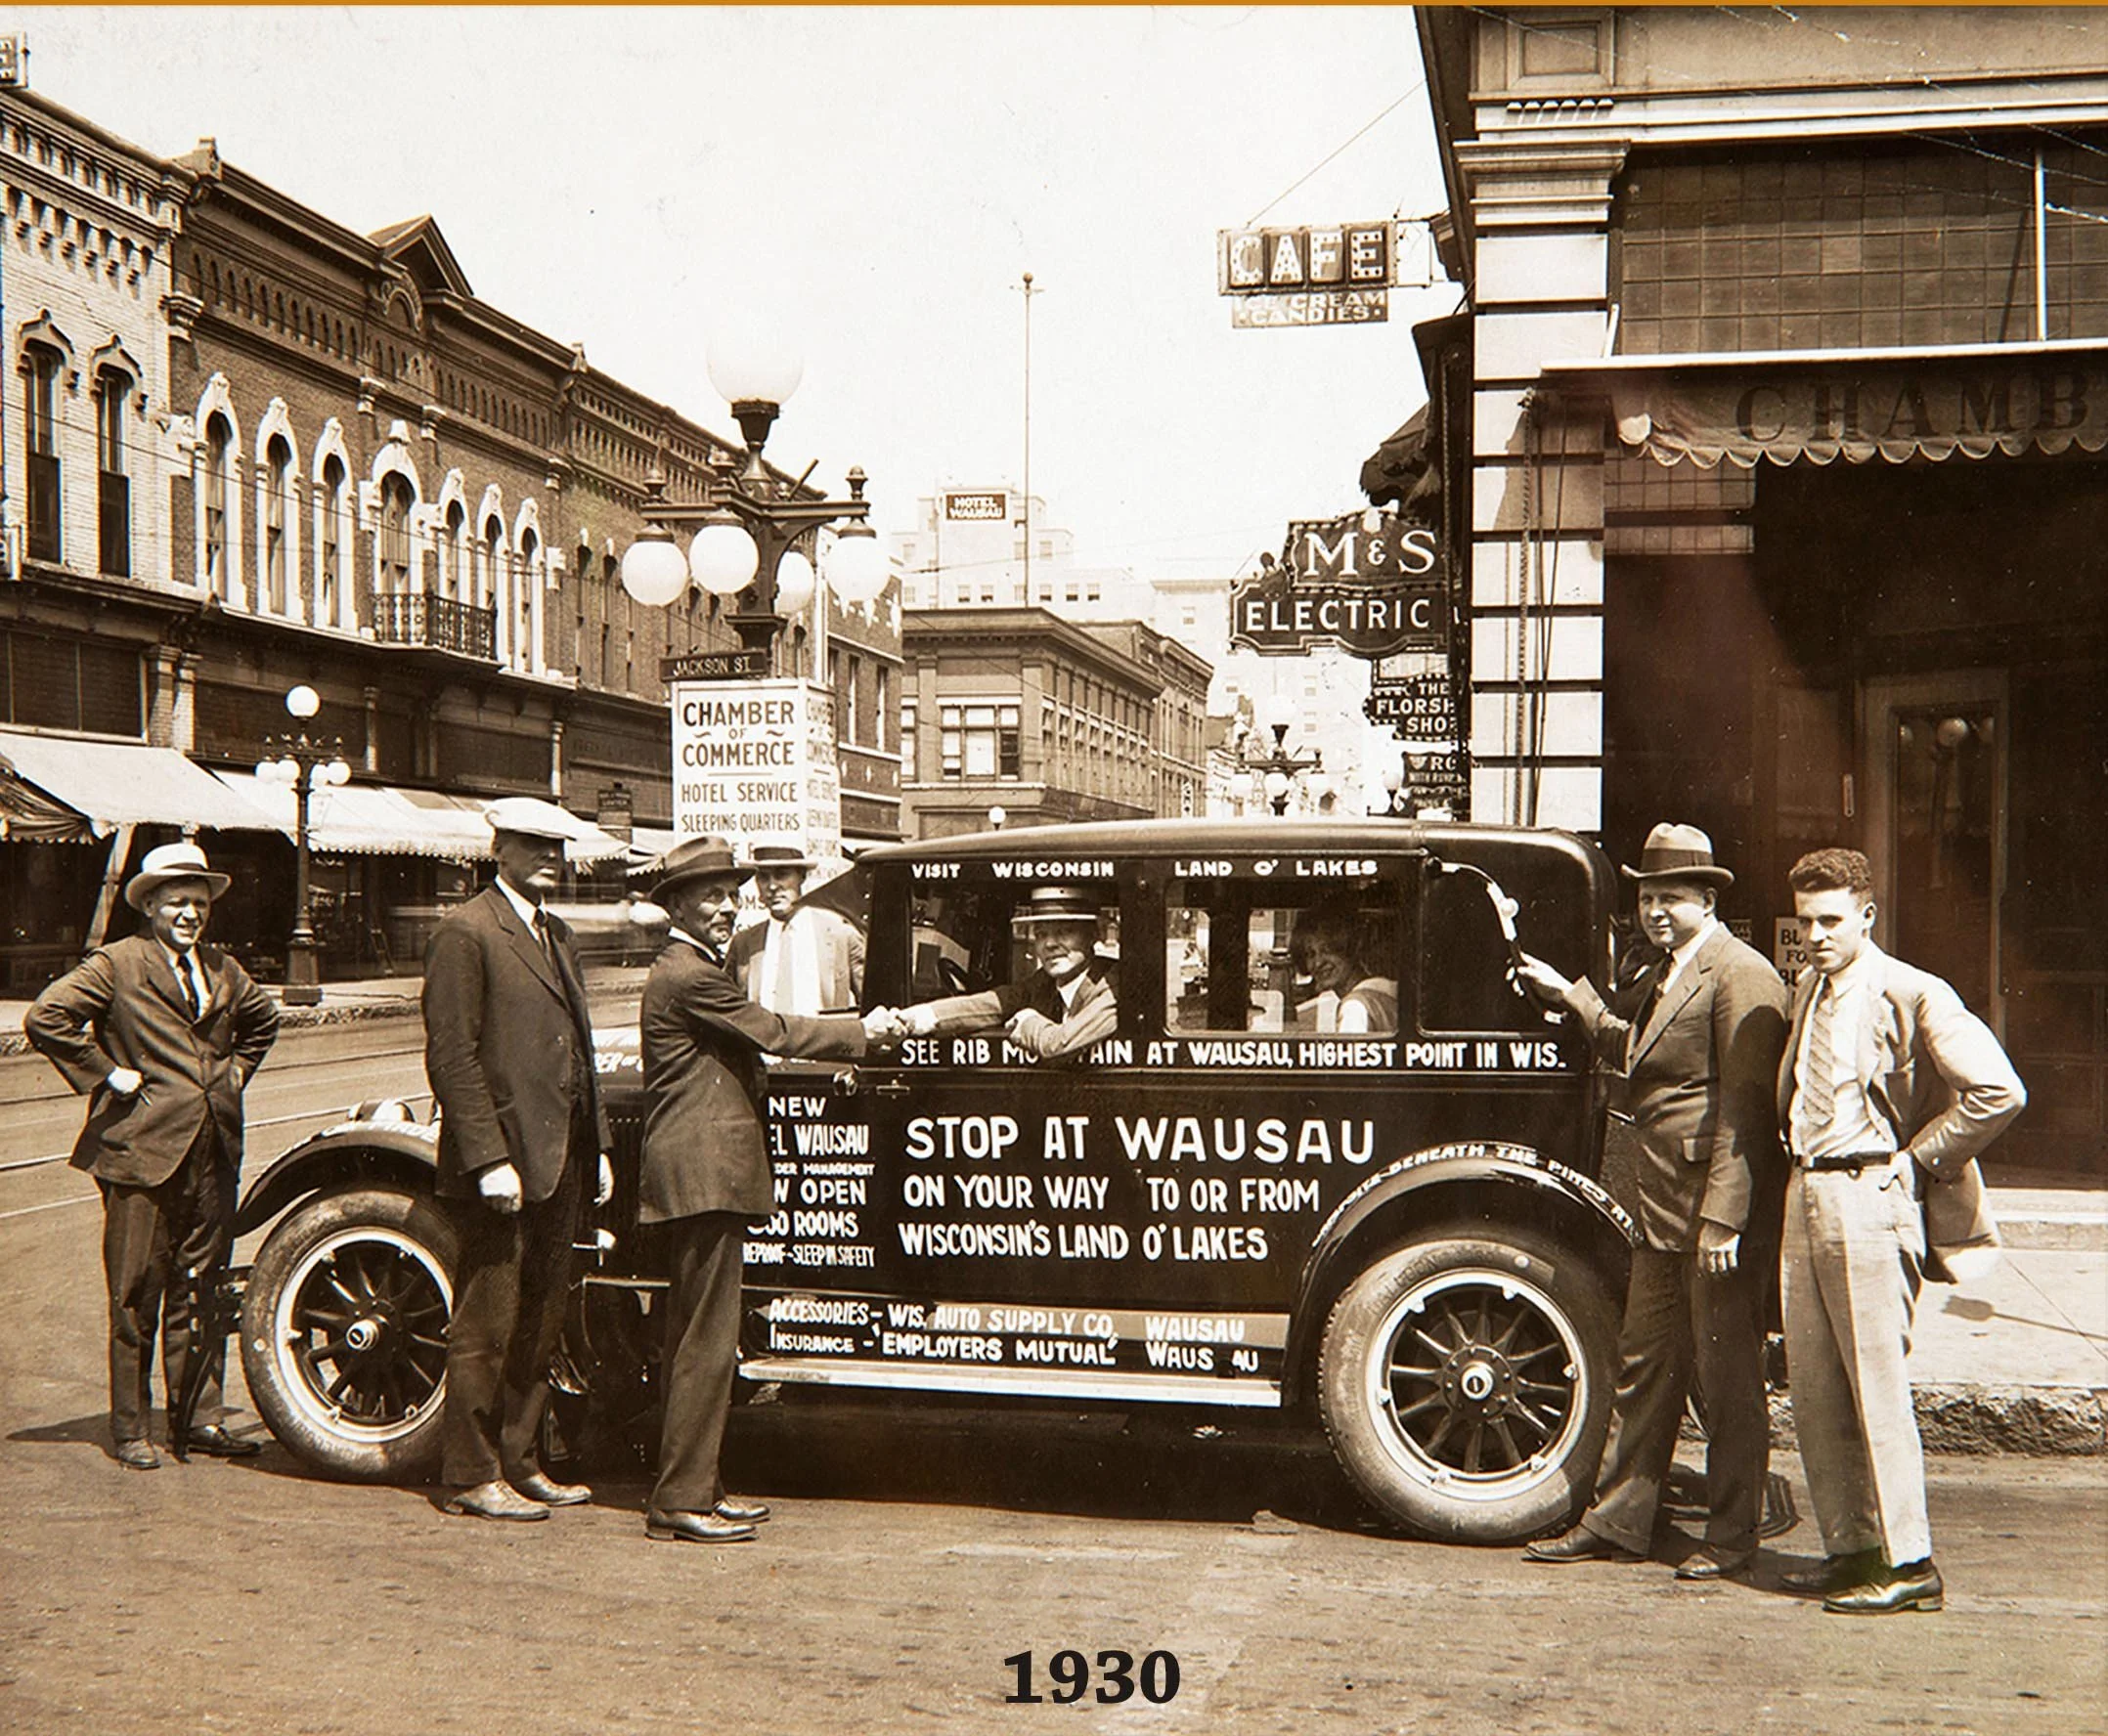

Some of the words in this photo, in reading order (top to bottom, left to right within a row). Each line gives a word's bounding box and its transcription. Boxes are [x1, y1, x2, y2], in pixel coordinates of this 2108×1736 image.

[1230, 231, 1383, 283] CAFE
[1291, 289, 1385, 308] CREAM
[1251, 306, 1369, 324] CANDIES
[953, 497, 996, 507] HOTEL
[1304, 533, 1358, 577] M
[1368, 539, 1385, 566] &
[1398, 530, 1435, 574] S
[1245, 598, 1430, 631] ELECTRIC
[673, 657, 728, 676] JACKSON
[734, 656, 751, 673] ST
[1418, 683, 1449, 695] THE
[683, 701, 795, 726] CHAMBER
[1406, 716, 1447, 732] SHO
[728, 727, 748, 740] OF
[682, 741, 795, 767] COMMERCE
[681, 783, 727, 803] HOTEL
[737, 782, 798, 803] SERVICE
[681, 813, 736, 832] SLEEPING
[740, 813, 800, 834] QUARTERS
[912, 864, 960, 879] VISIT
[992, 862, 1115, 877] WISCONSIN
[1175, 861, 1233, 877] LAND
[1253, 859, 1279, 876] O'
[1296, 860, 1378, 876] LAKES
[901, 1039, 939, 1064] SEE
[952, 1039, 990, 1063] RIB
[1002, 1040, 1132, 1064] MAIN
[1147, 1041, 1177, 1064] AT
[1299, 1041, 1397, 1066] HIGHEST
[1406, 1042, 1466, 1066] POINT
[1476, 1043, 1497, 1066] IN
[1510, 1043, 1566, 1067] WIS.
[769, 1096, 826, 1117] NEW
[794, 1124, 869, 1155] WAUSAU
[904, 1115, 1019, 1160] STOP
[1043, 1116, 1089, 1160] AT
[1115, 1117, 1374, 1164] WAUSAU
[773, 1162, 798, 1175] DER
[803, 1163, 875, 1176] MANAGEMENT
[1389, 1144, 1485, 1174] BENEATH
[1496, 1146, 1537, 1165] THE
[800, 1178, 866, 1204] OPEN
[903, 1174, 944, 1208] ON
[955, 1175, 1033, 1209] YOUR
[1043, 1176, 1109, 1209] WAY
[1147, 1177, 1179, 1211] TO
[1190, 1178, 1228, 1212] OR
[1241, 1179, 1319, 1212] FROM
[793, 1211, 858, 1237] ROOMS
[899, 1220, 1051, 1256] WISCONSIN'S
[1059, 1224, 1129, 1259] LAND
[1143, 1223, 1166, 1261] O'
[1173, 1227, 1268, 1261] LAKES
[934, 1306, 981, 1331] AUTO
[987, 1310, 1076, 1334] SUPPLY
[1145, 1316, 1245, 1342] WAUSAU
[769, 1324, 855, 1353] INSURANCE
